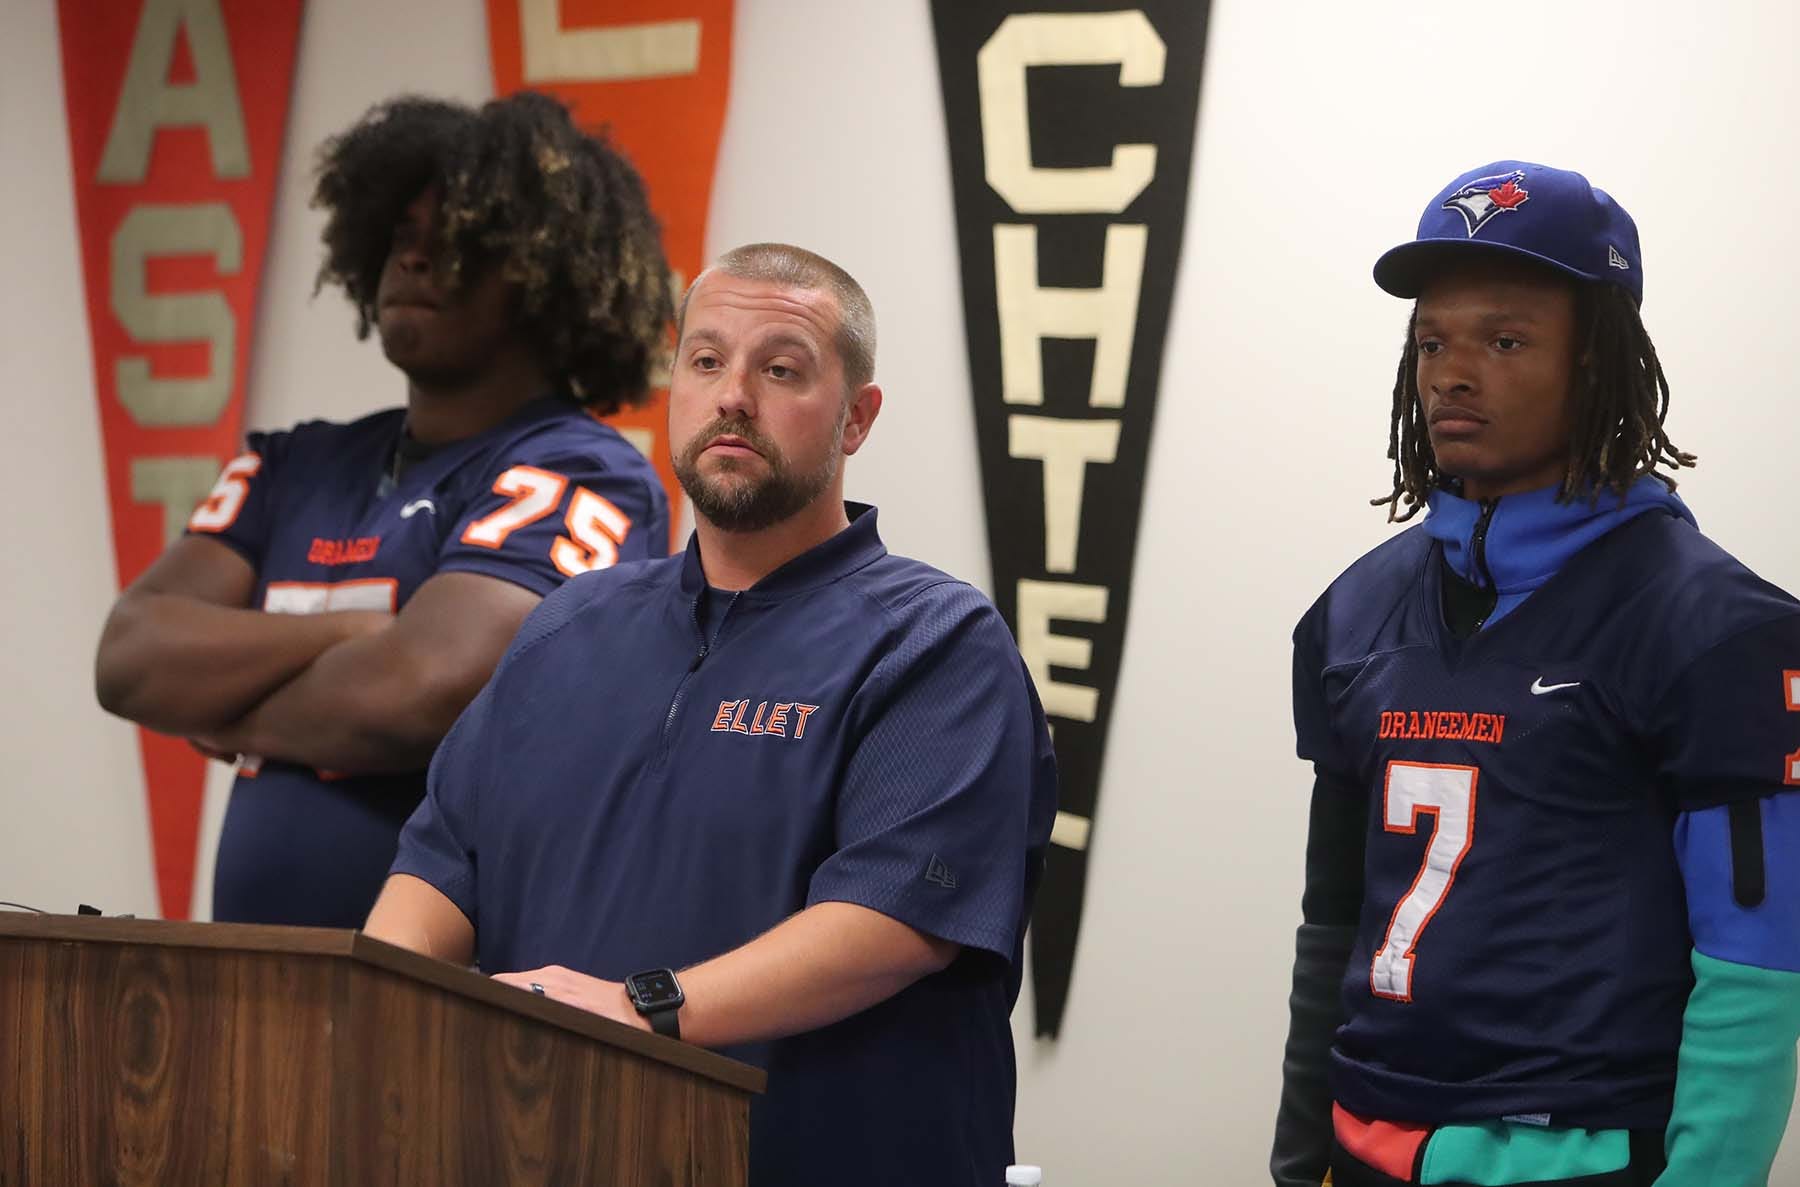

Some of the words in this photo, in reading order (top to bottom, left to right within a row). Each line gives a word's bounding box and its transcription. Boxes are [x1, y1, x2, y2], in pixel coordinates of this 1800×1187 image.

[976, 10, 1168, 850] CHTE
[460, 464, 633, 579] 75
[710, 699, 820, 740] ELLET
[1378, 711, 1505, 744] ORANGEMEN
[1369, 760, 1479, 1003] 7
